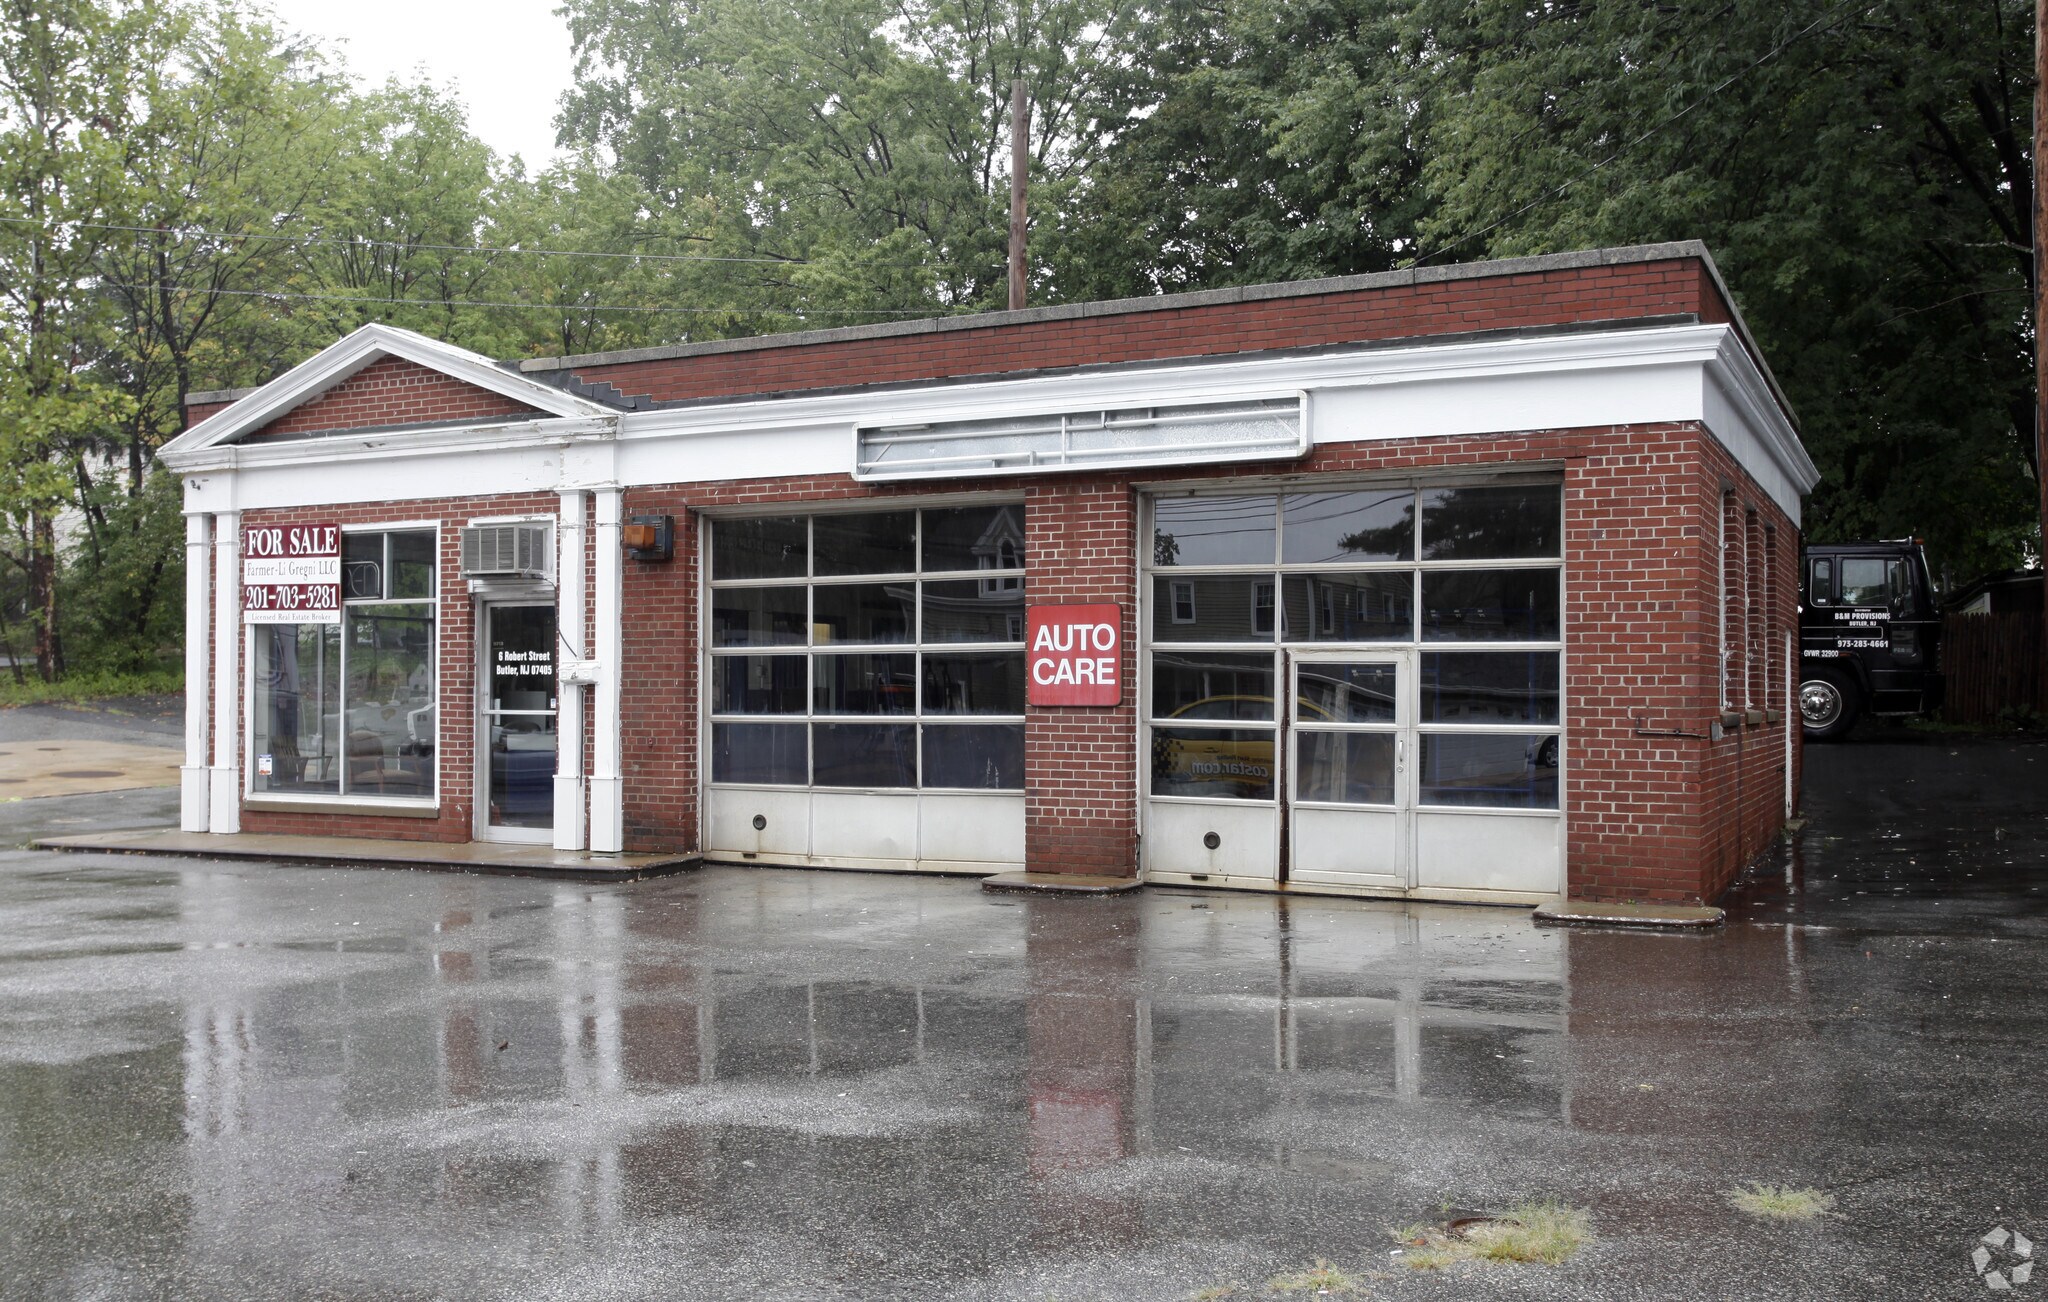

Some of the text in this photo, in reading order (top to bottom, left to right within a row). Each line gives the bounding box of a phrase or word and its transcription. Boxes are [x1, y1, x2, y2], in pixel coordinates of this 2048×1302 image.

[247, 526, 337, 556] FOR SALE
[247, 560, 336, 580] Farmer-Li Gregni LLC
[246, 585, 337, 609] 201-703-5281
[251, 612, 331, 621] Licensed Real Estate Broker
[1834, 612, 1891, 620] B&M PROVISIONS
[1033, 623, 1116, 651] AUTO
[498, 650, 550, 661] 6 Robert Street
[496, 664, 552, 676] Butler, NJ 07405
[1033, 658, 1116, 685] CARE
